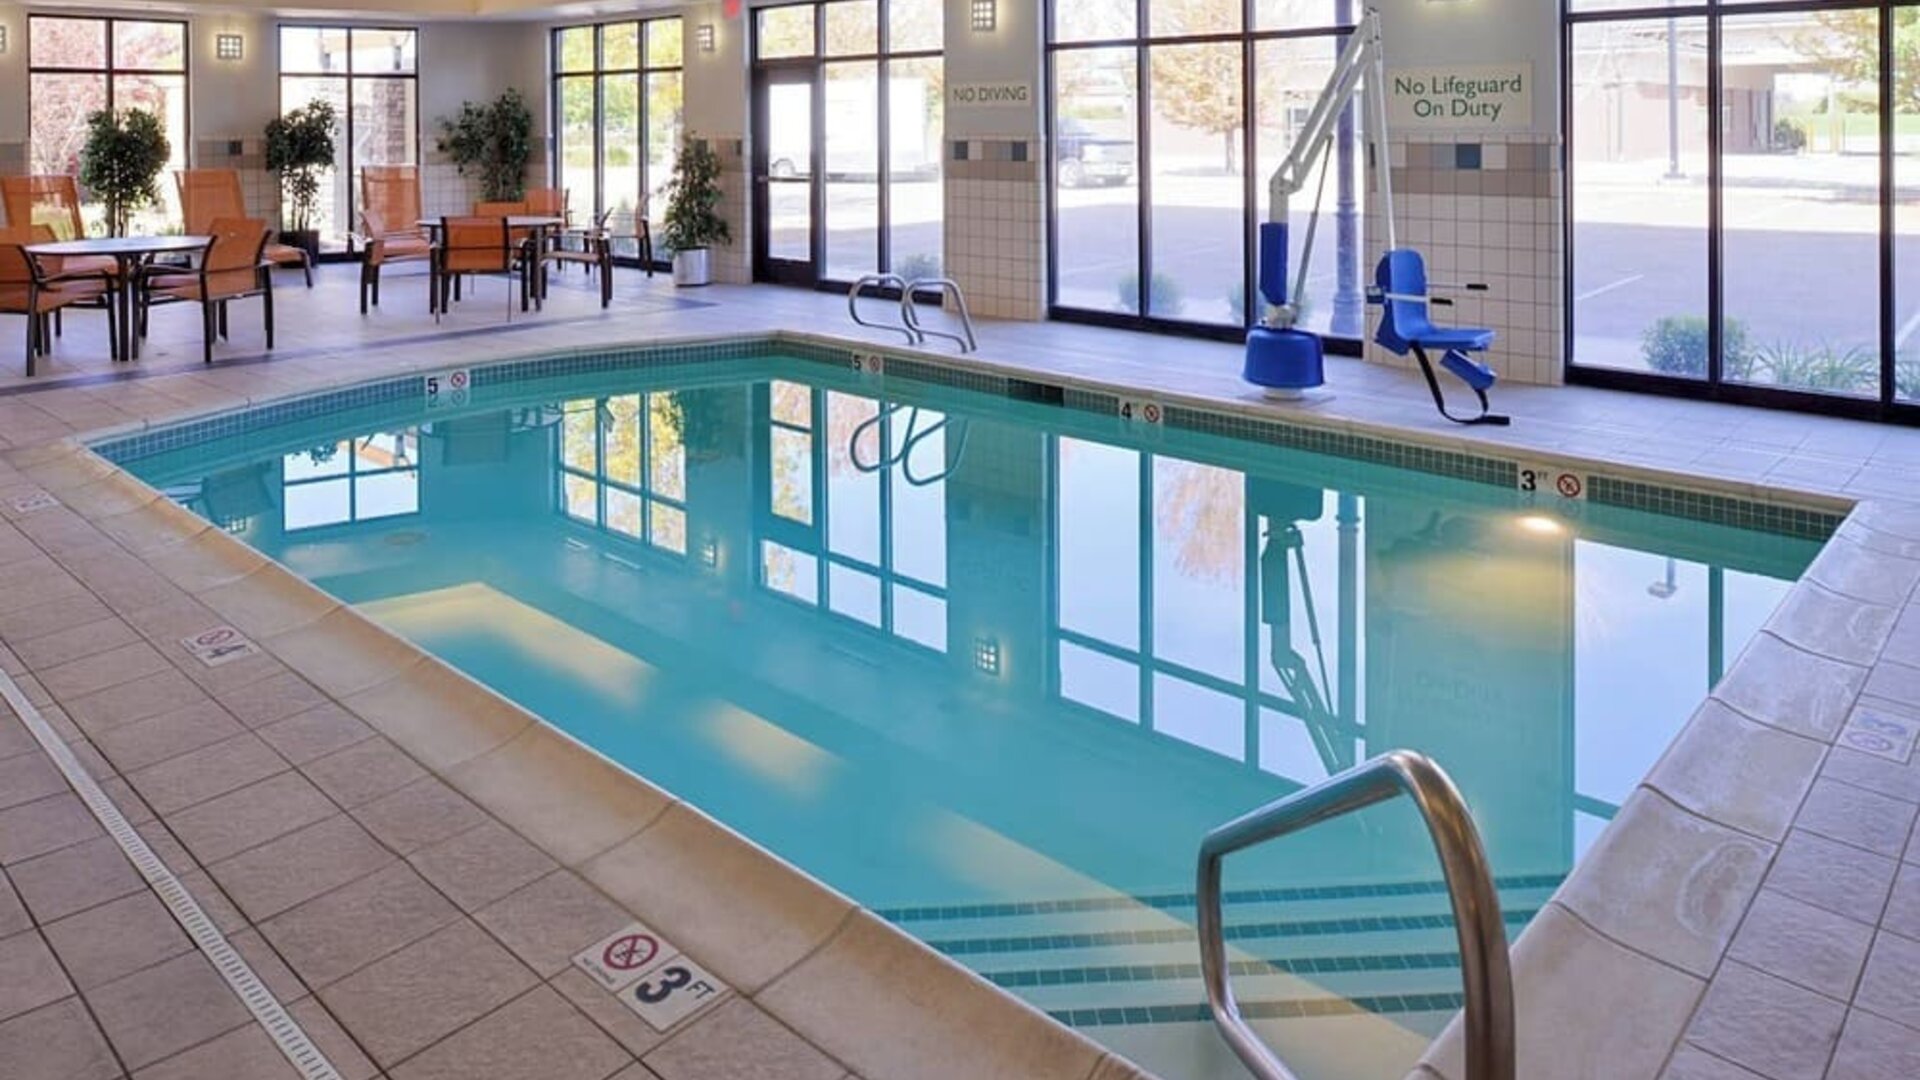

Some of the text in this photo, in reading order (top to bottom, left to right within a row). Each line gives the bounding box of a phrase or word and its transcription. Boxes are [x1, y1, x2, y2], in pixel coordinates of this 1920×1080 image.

[953, 85, 1027, 102] NO DIVING
[1395, 74, 1522, 99] No Lifeguard
[1414, 99, 1502, 122] On Duty
[853, 354, 861, 370] 5
[427, 377, 439, 394] 5
[1121, 401, 1132, 418] 4
[1521, 469, 1537, 491] 3
[635, 966, 692, 1004] 3
[684, 980, 716, 999] FT
